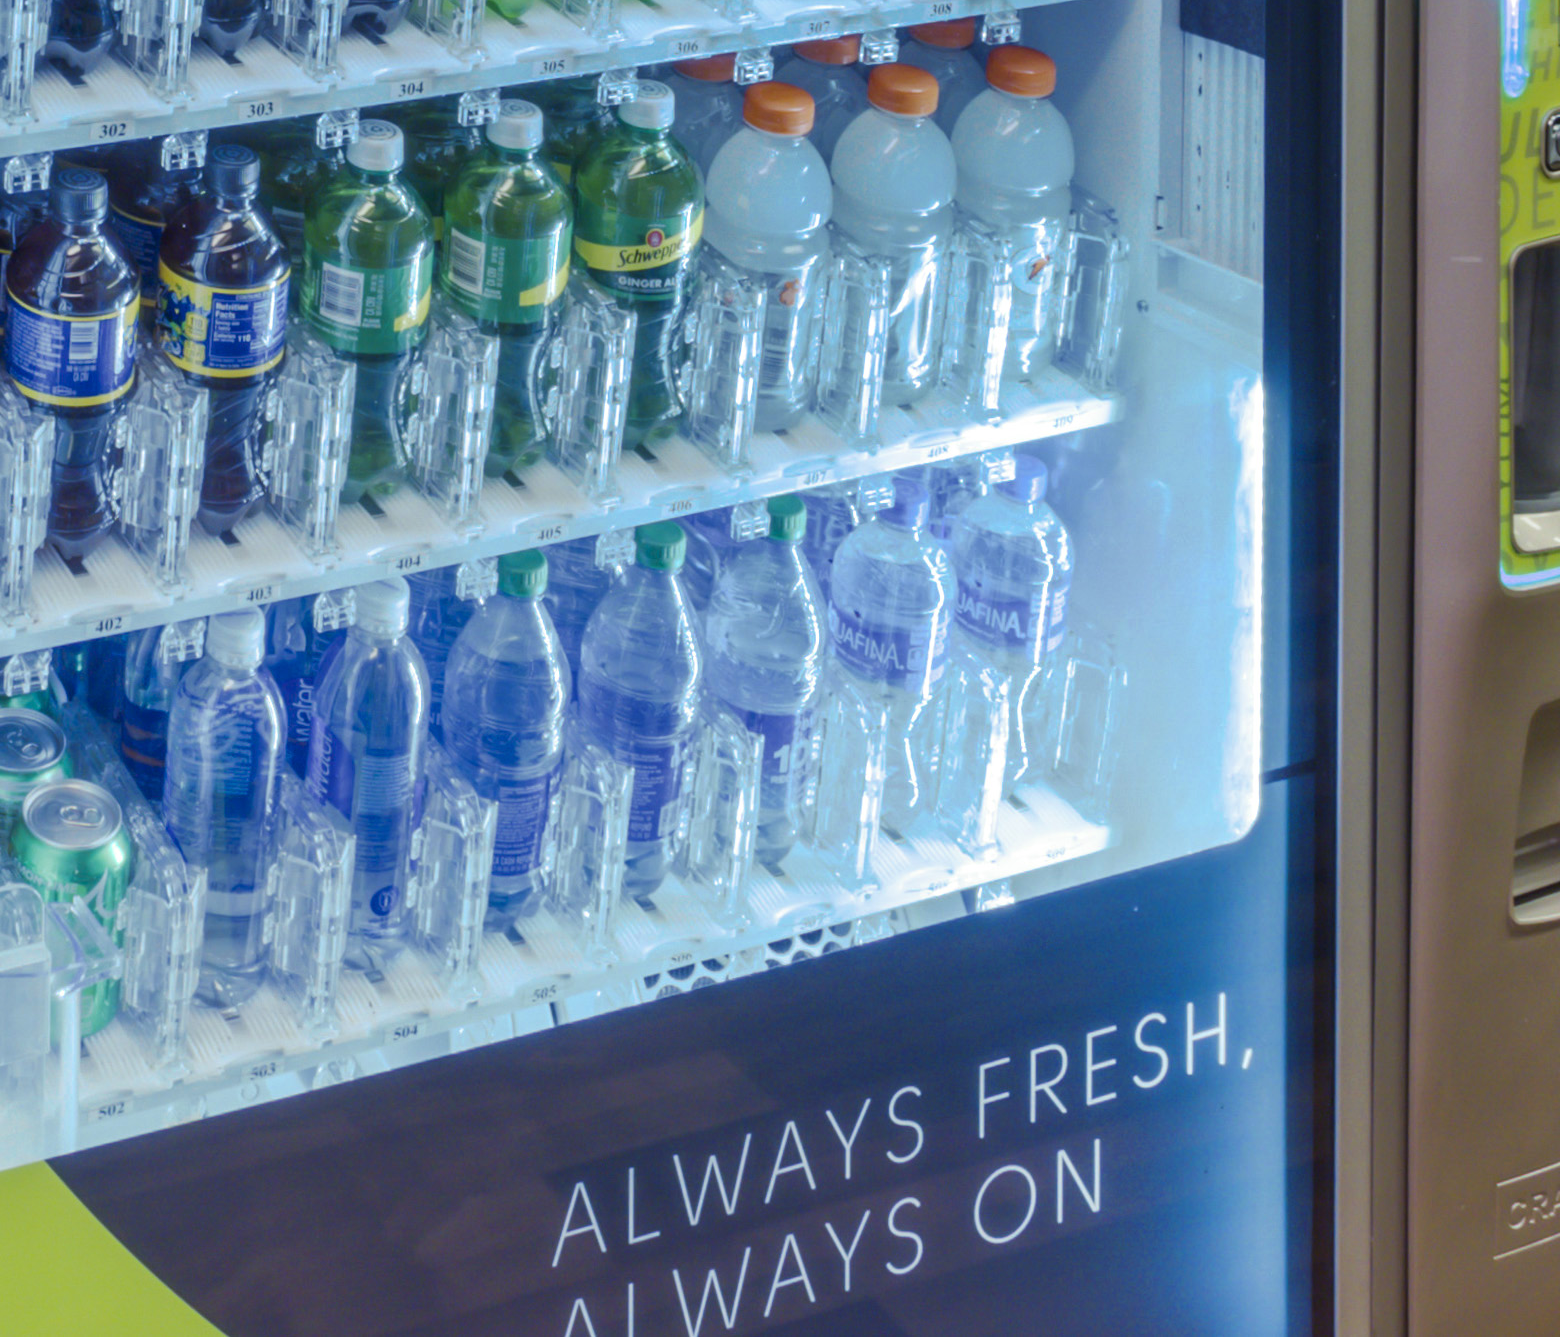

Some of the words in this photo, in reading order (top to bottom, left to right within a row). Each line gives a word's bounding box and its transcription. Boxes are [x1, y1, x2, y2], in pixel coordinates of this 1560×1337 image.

[397, 81, 426, 97] 304
[98, 122, 128, 139] 302
[617, 275, 662, 290] GINGER
[395, 554, 422, 571] 404
[551, 1084, 925, 1268] ALWAYS
[979, 992, 1254, 1140] FRESH,
[972, 1138, 1102, 1245] ON
